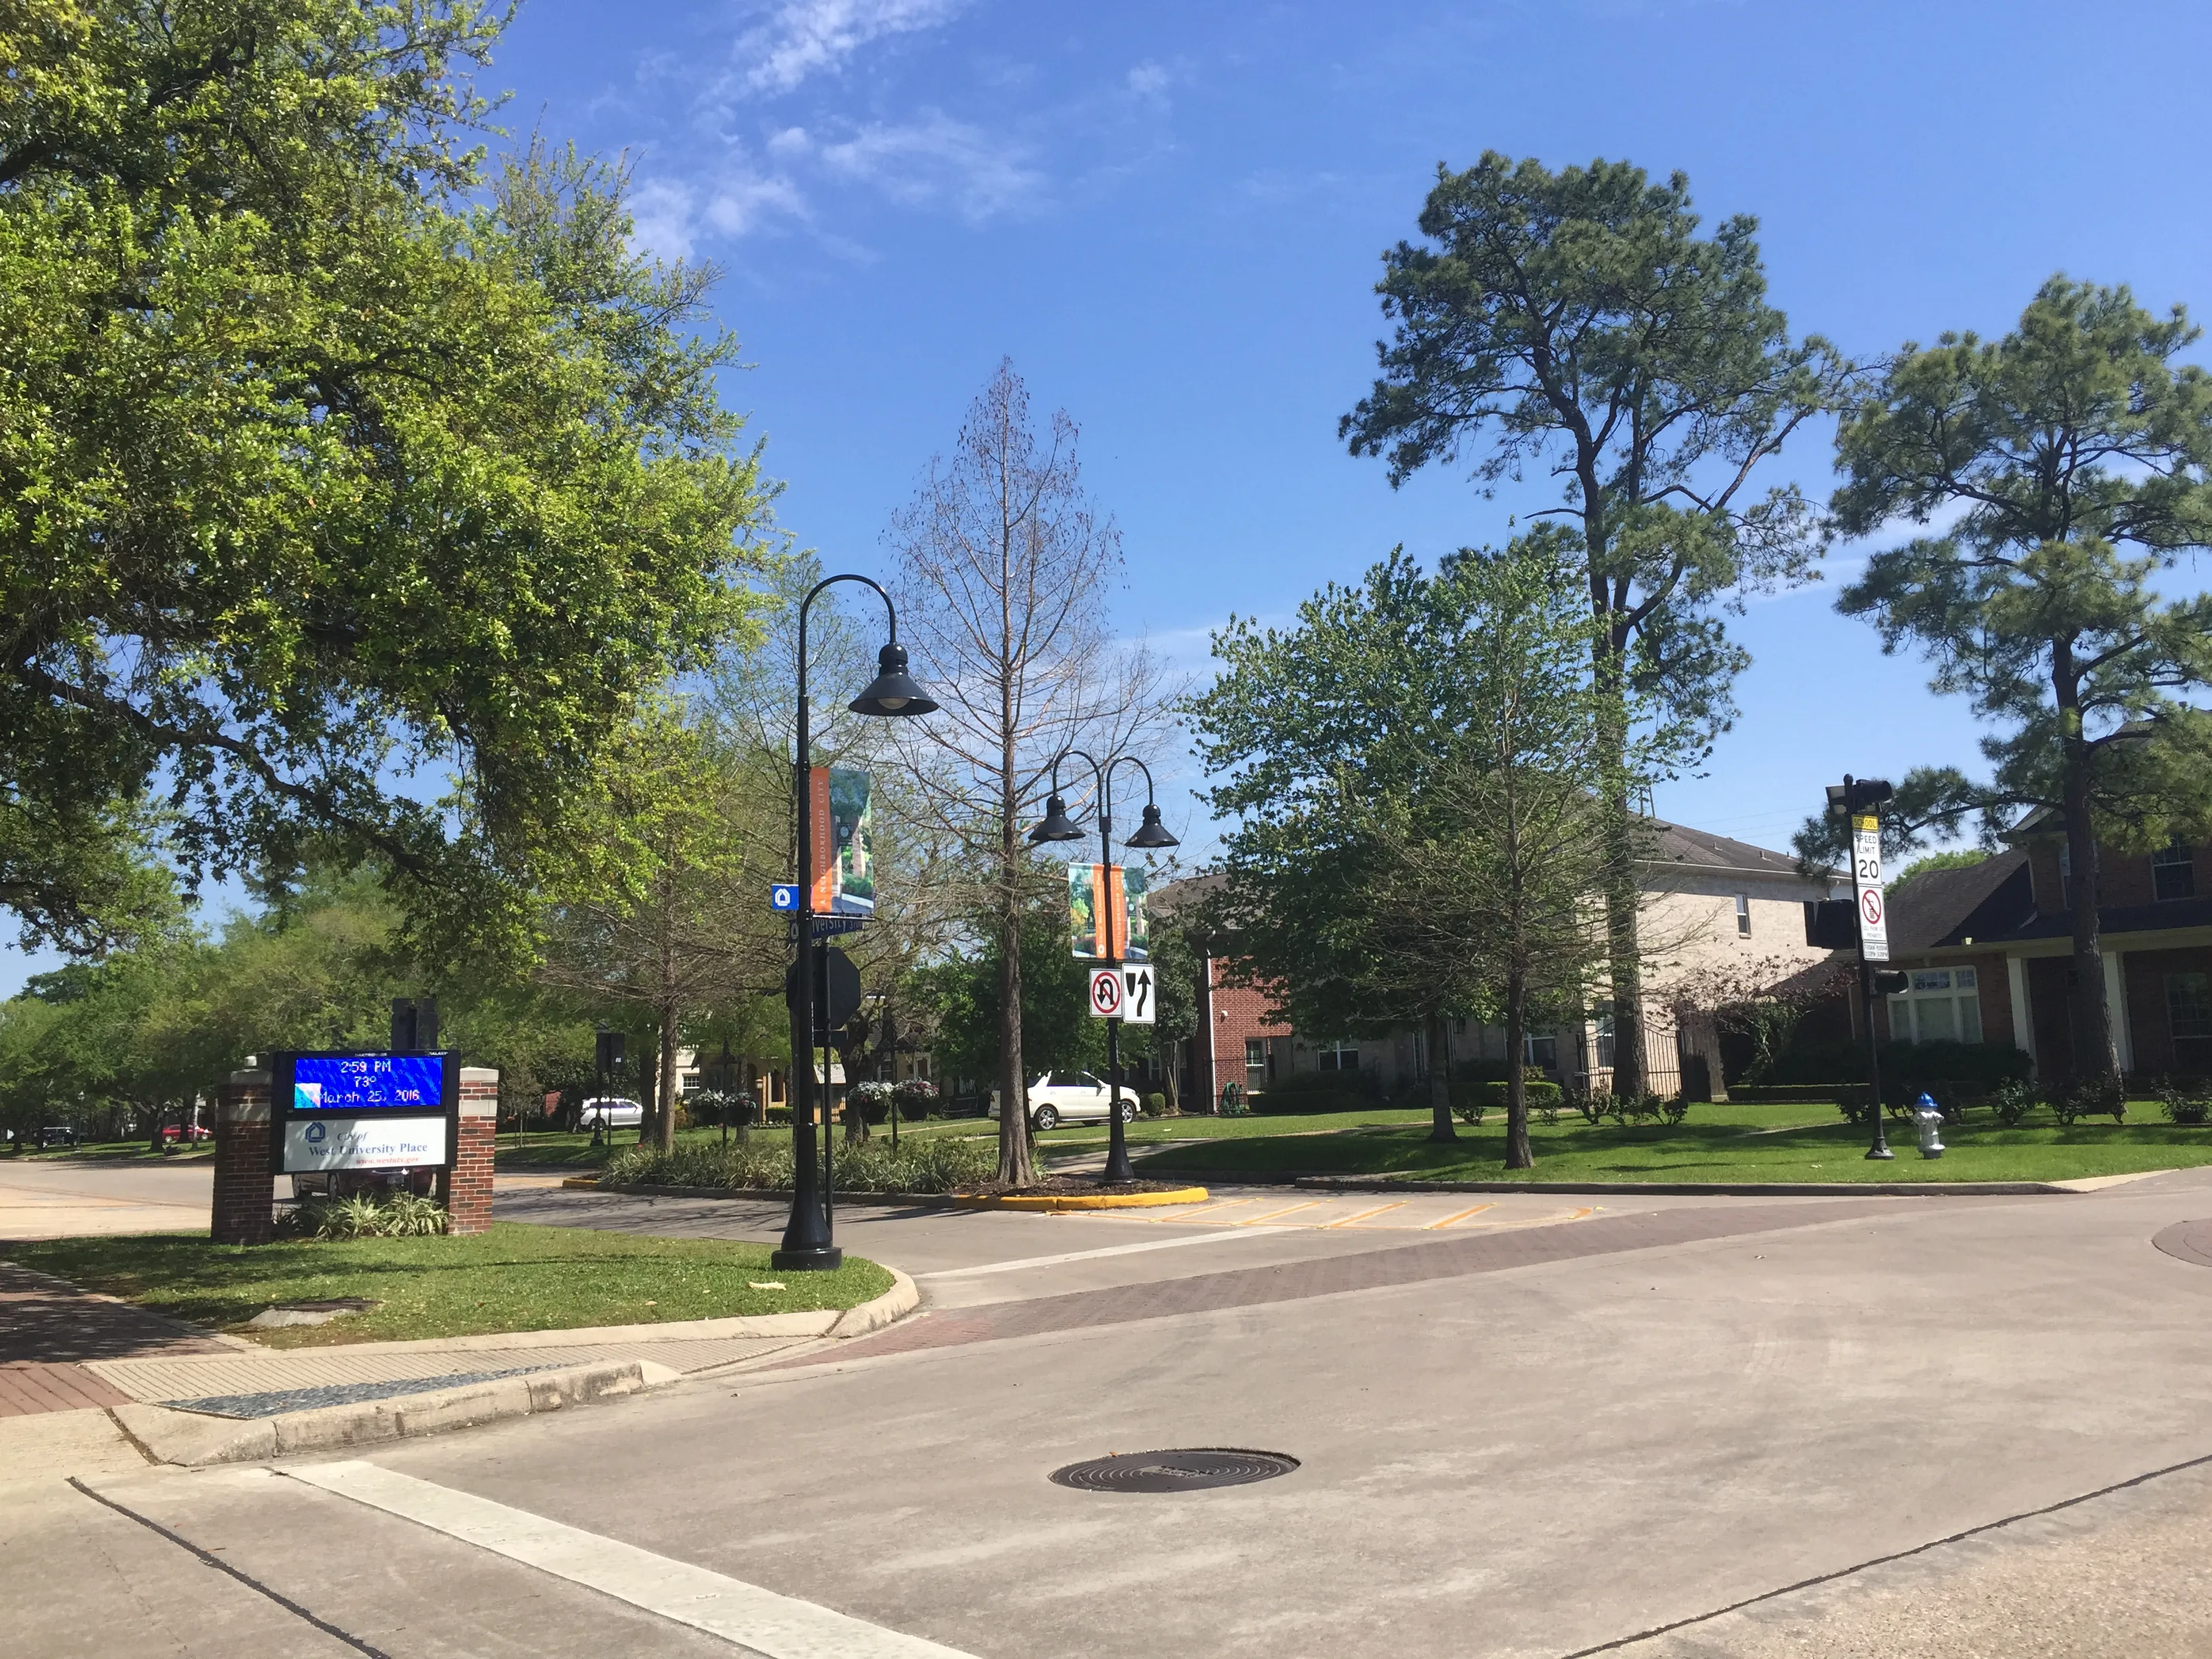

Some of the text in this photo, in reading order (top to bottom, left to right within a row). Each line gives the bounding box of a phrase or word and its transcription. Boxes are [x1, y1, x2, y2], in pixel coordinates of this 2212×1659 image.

[1853, 818, 1877, 828] SCHOOL
[1856, 834, 1877, 844] SPEED
[819, 809, 827, 893] NEIGHBORHOOD
[1859, 846, 1875, 855] LIMIT
[1858, 859, 1879, 879] 20
[812, 919, 846, 933] iversity
[340, 1060, 392, 1073] 2:59 PM
[354, 1076, 377, 1088] 73°
[321, 1088, 420, 1103] March 25, 2016
[337, 1131, 369, 1141] City of
[309, 1143, 428, 1157] West University Place
